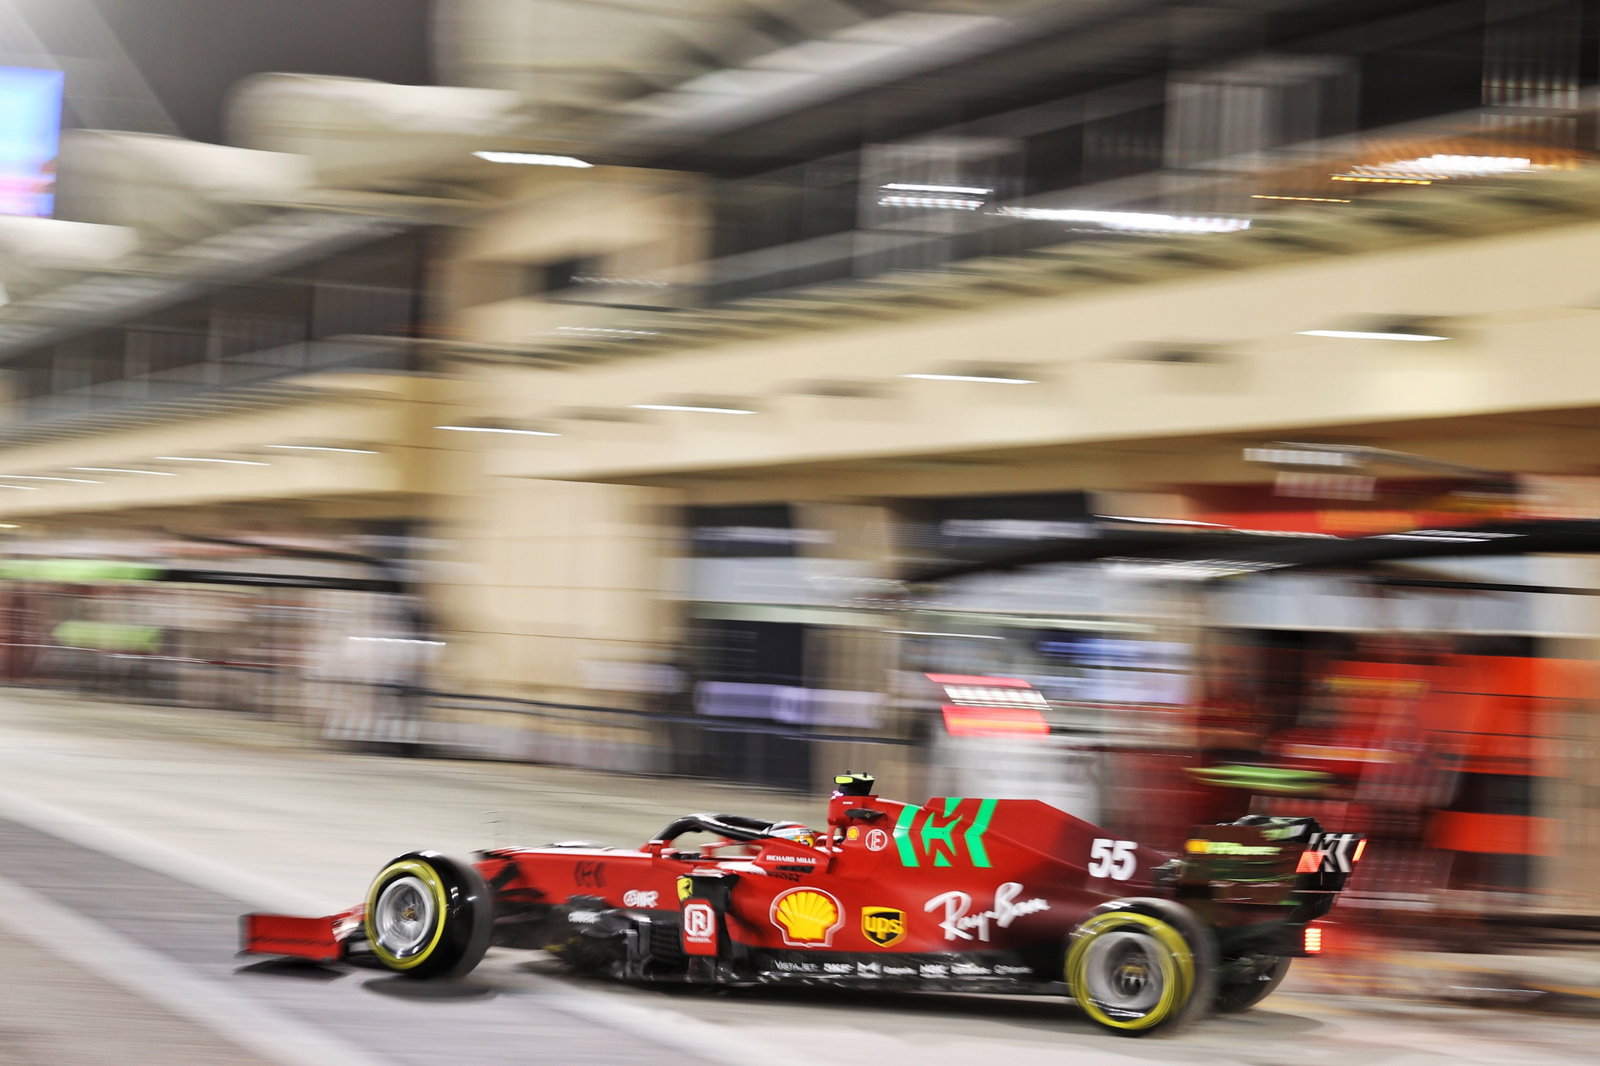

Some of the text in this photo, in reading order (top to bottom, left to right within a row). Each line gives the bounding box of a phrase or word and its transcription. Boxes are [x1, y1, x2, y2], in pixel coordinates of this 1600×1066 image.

[766, 854, 817, 864] RICHARD MILLE
[1088, 838, 1138, 881] 55
